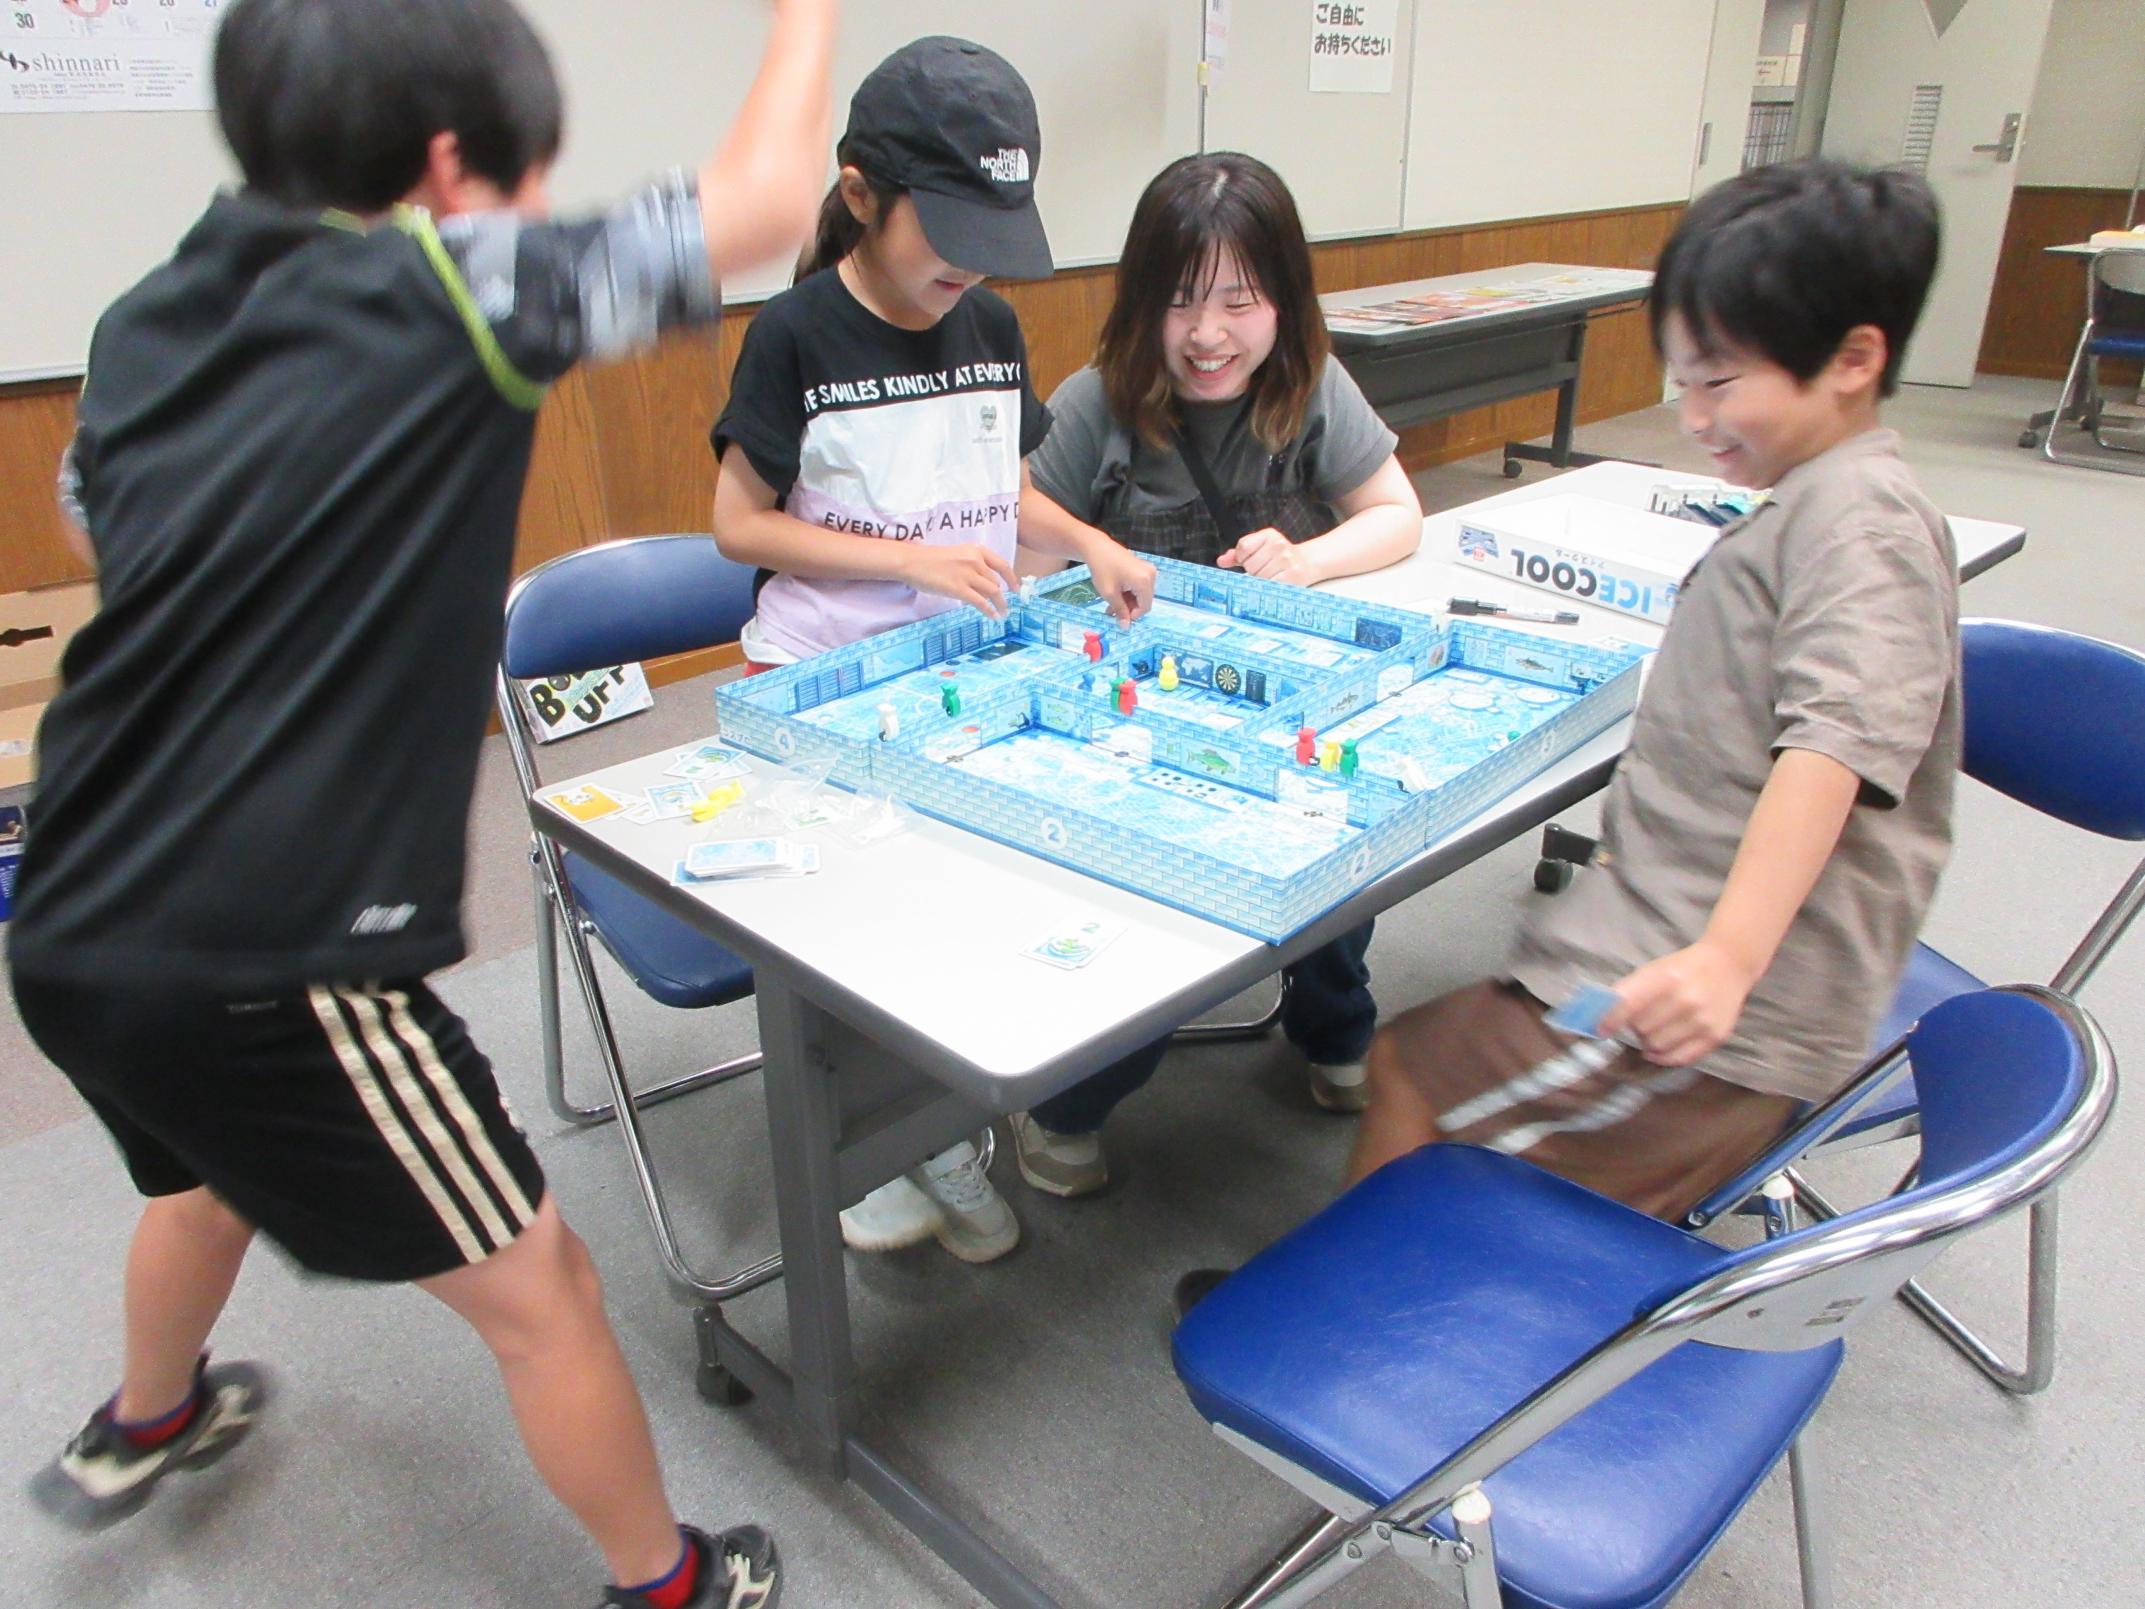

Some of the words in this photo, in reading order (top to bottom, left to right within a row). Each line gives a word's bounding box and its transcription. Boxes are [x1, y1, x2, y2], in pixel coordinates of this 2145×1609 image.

[15, 12, 35, 29] 30
[1316, 3, 1365, 26] ご自由に
[1314, 33, 1391, 57] お持ちください
[32, 53, 120, 71] shinnari
[980, 155, 1018, 172] NORTH
[998, 148, 1018, 162] THE
[991, 170, 1017, 182] FACE
[883, 370, 949, 397] KINDLY
[955, 366, 973, 387] AT
[824, 511, 887, 539] EVERY
